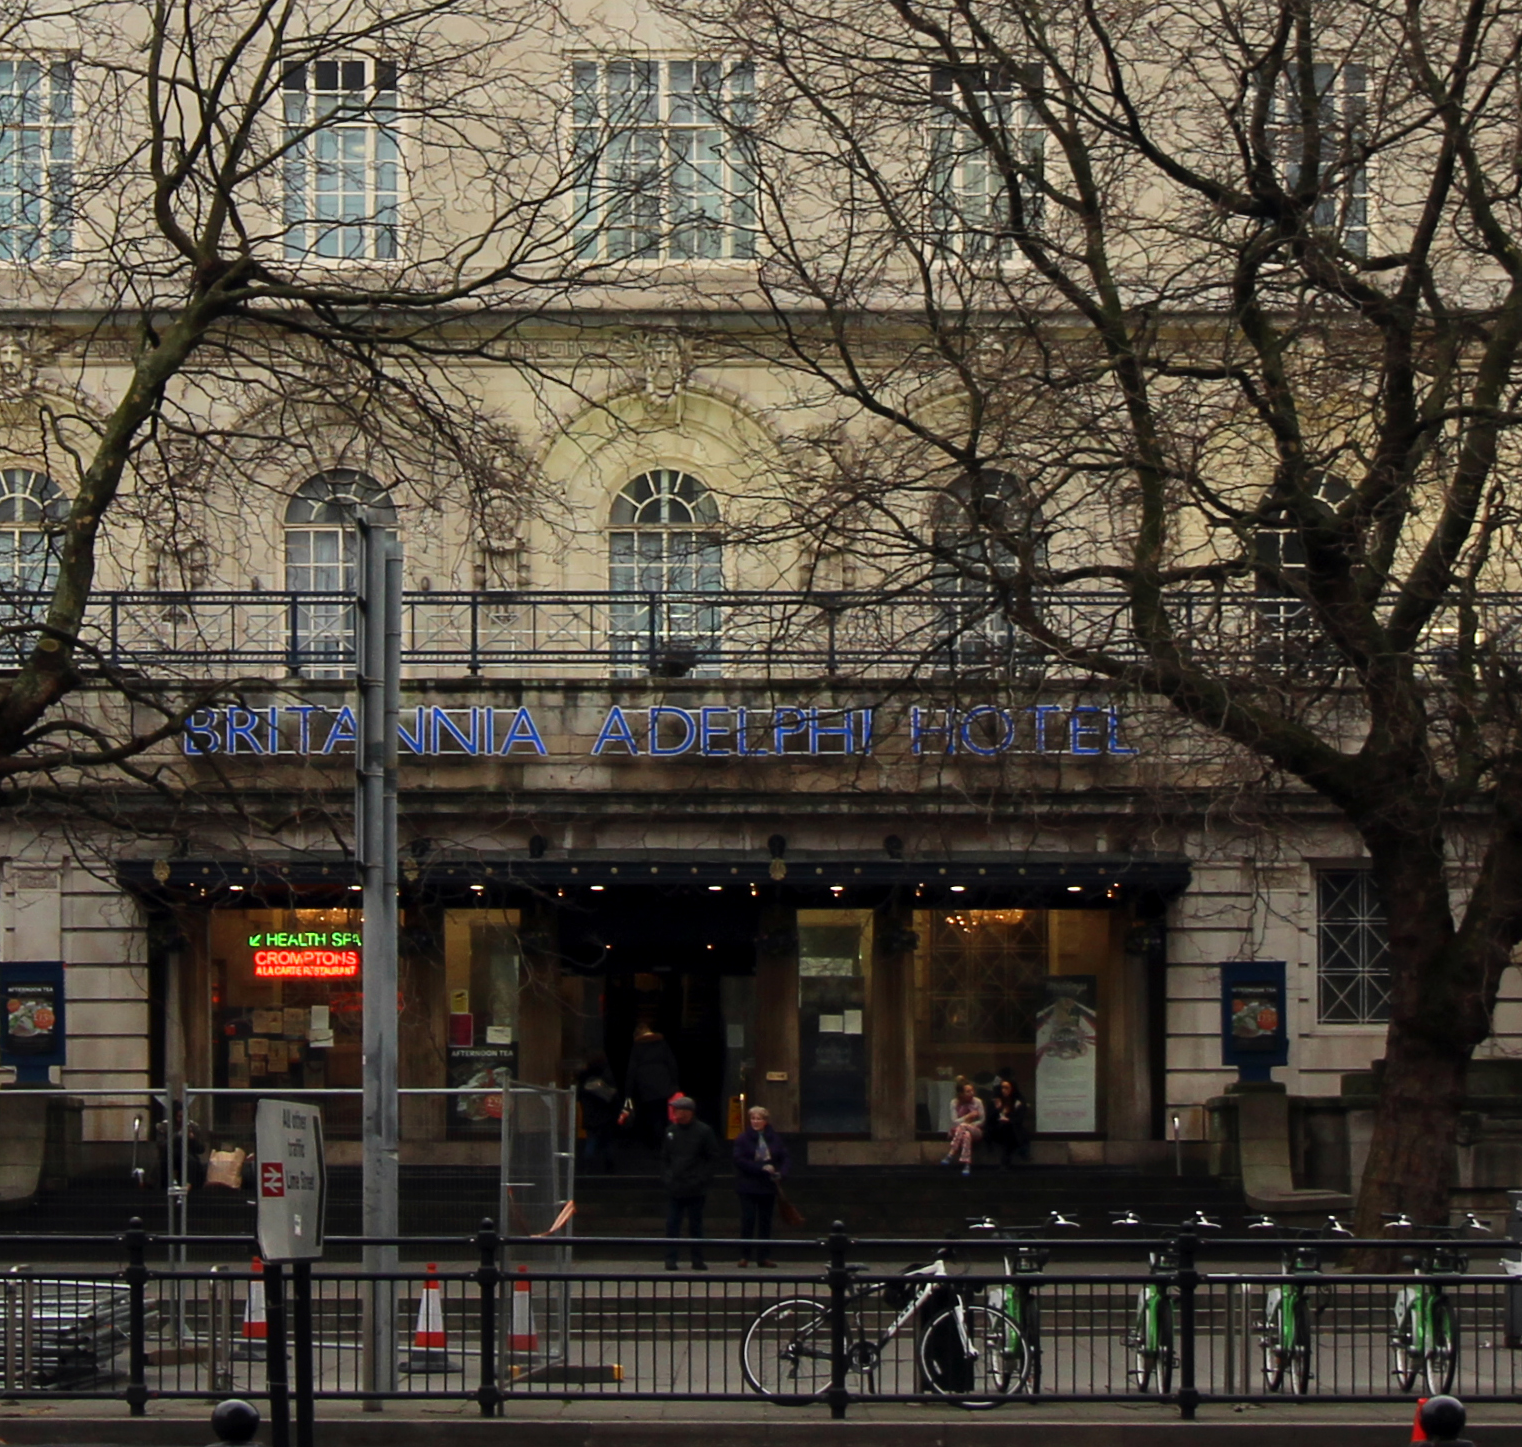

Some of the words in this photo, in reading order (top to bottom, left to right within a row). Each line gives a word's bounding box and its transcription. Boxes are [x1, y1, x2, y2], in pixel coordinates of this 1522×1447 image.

[183, 704, 548, 756] BRITANNIA
[590, 705, 873, 756] ADELPHI
[910, 704, 1139, 756] HOTEL
[266, 932, 326, 947] HEALTH
[331, 932, 362, 947] SPA
[255, 951, 357, 966] CROMPTONS
[274, 966, 302, 976] CARTE
[303, 966, 356, 976] RESTAURANT
[283, 1108, 291, 1128] All
[291, 1110, 307, 1130] other
[287, 1138, 305, 1158] traffic
[286, 1169, 300, 1190] Lime
[300, 1170, 315, 1191] Street
